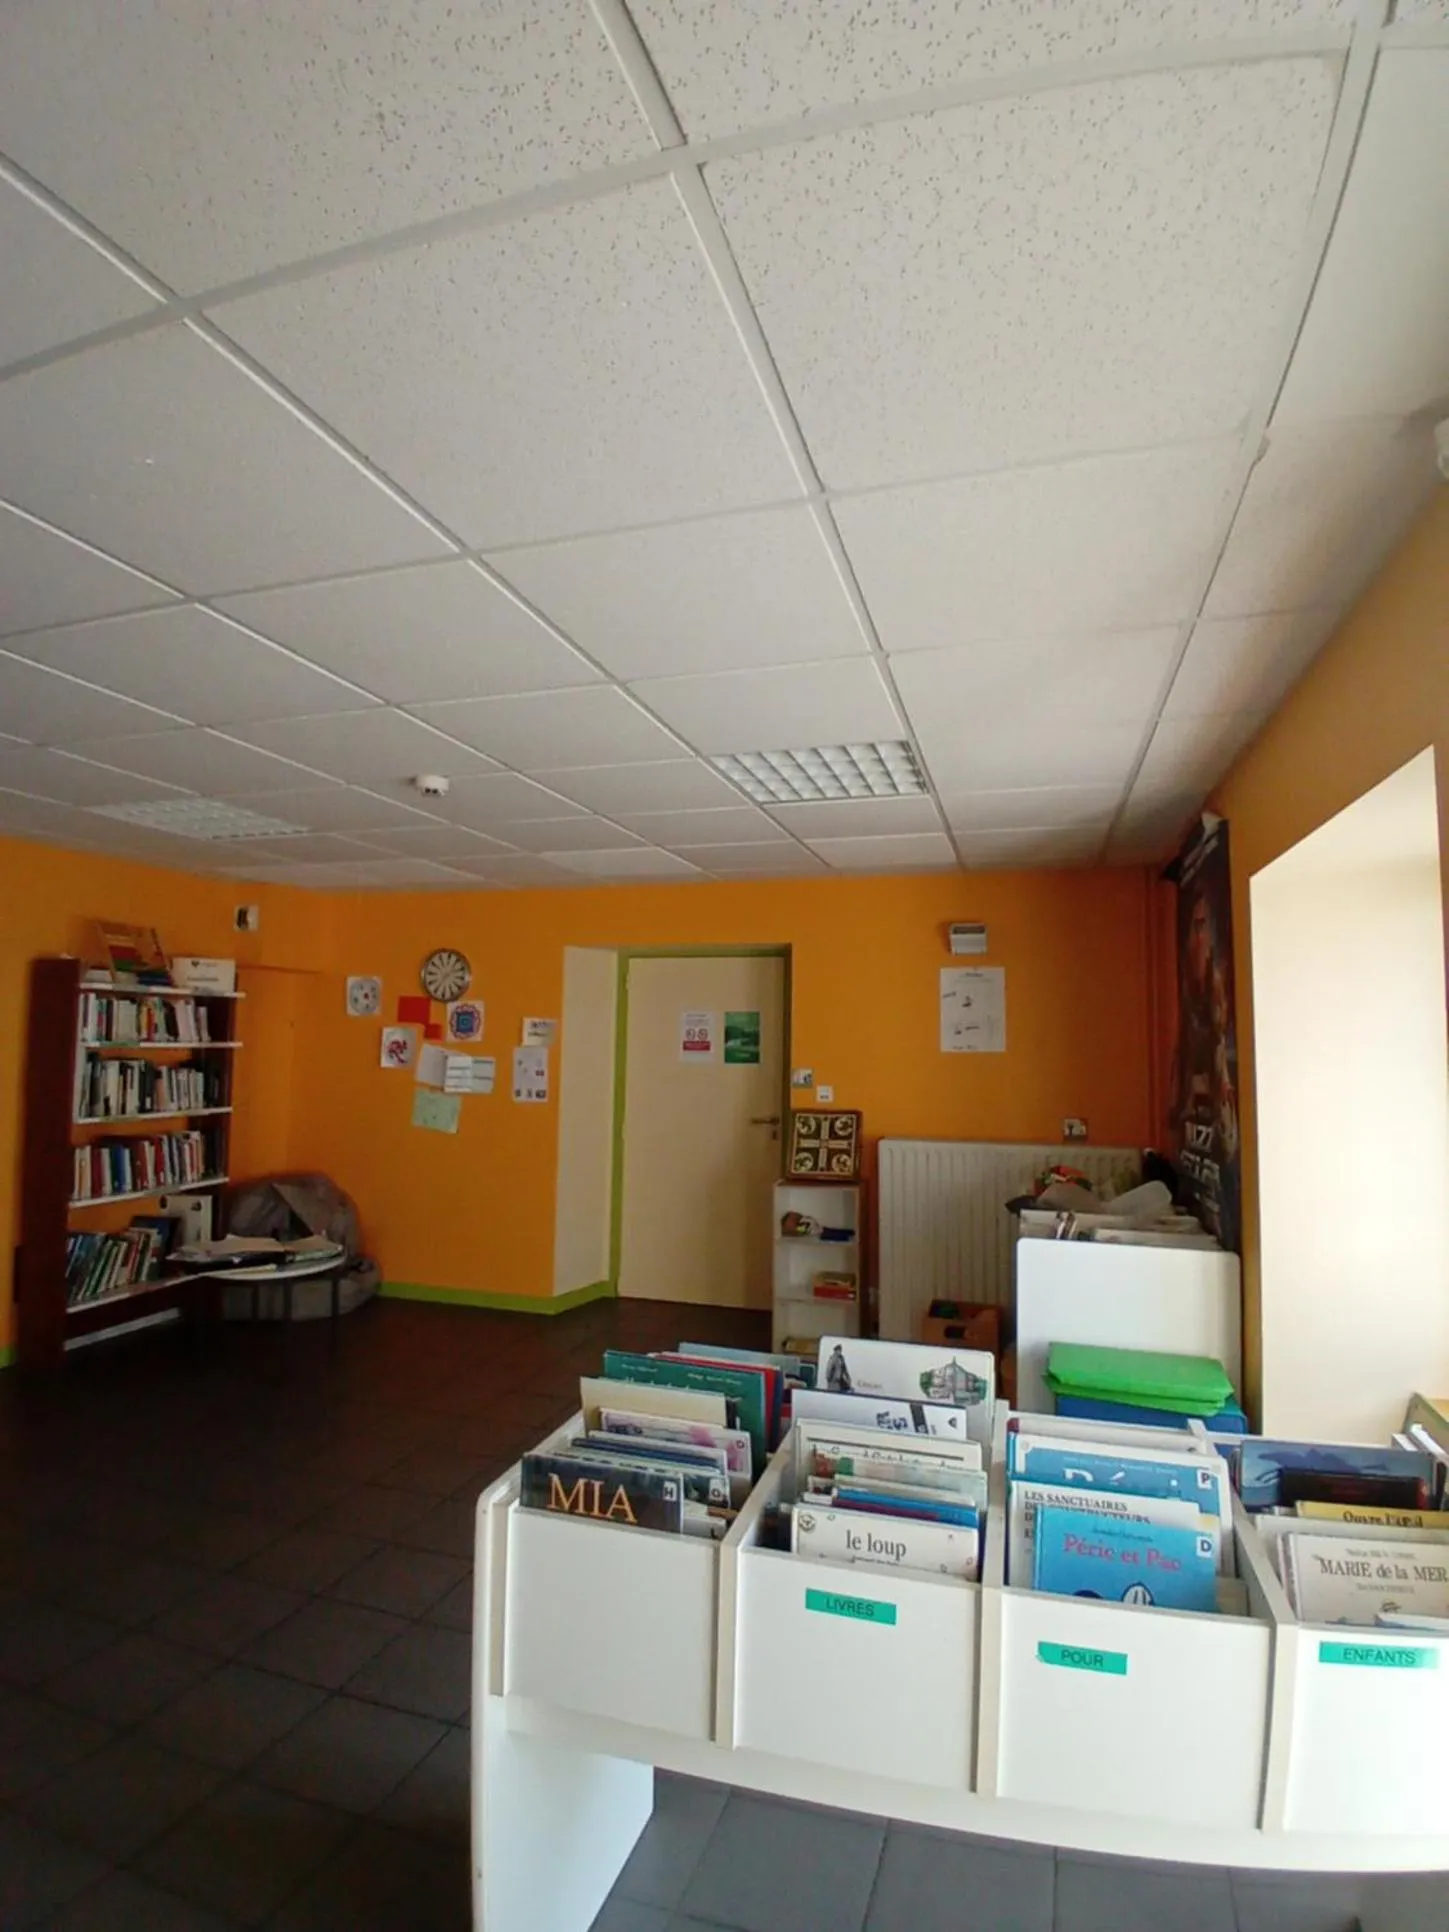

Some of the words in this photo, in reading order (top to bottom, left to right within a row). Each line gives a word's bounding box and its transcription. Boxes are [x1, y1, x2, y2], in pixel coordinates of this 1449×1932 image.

[1201, 1472, 1210, 1484] P
[547, 1472, 638, 1524] MIA
[664, 1487, 674, 1500] H
[1024, 1490, 1044, 1502] LES
[1046, 1493, 1128, 1512] SANCTUAIRES
[845, 1529, 862, 1551] le
[867, 1533, 907, 1561] loup
[1201, 1540, 1212, 1552] D
[1121, 1548, 1140, 1565] et
[1314, 1555, 1373, 1579] MARIE
[1376, 1563, 1393, 1579] de
[1394, 1563, 1409, 1581] la
[1413, 1564, 1448, 1583] MER
[826, 1597, 875, 1618] LIVRES
[1060, 1649, 1104, 1668] POUR
[1342, 1646, 1417, 1666] ENFANTS
